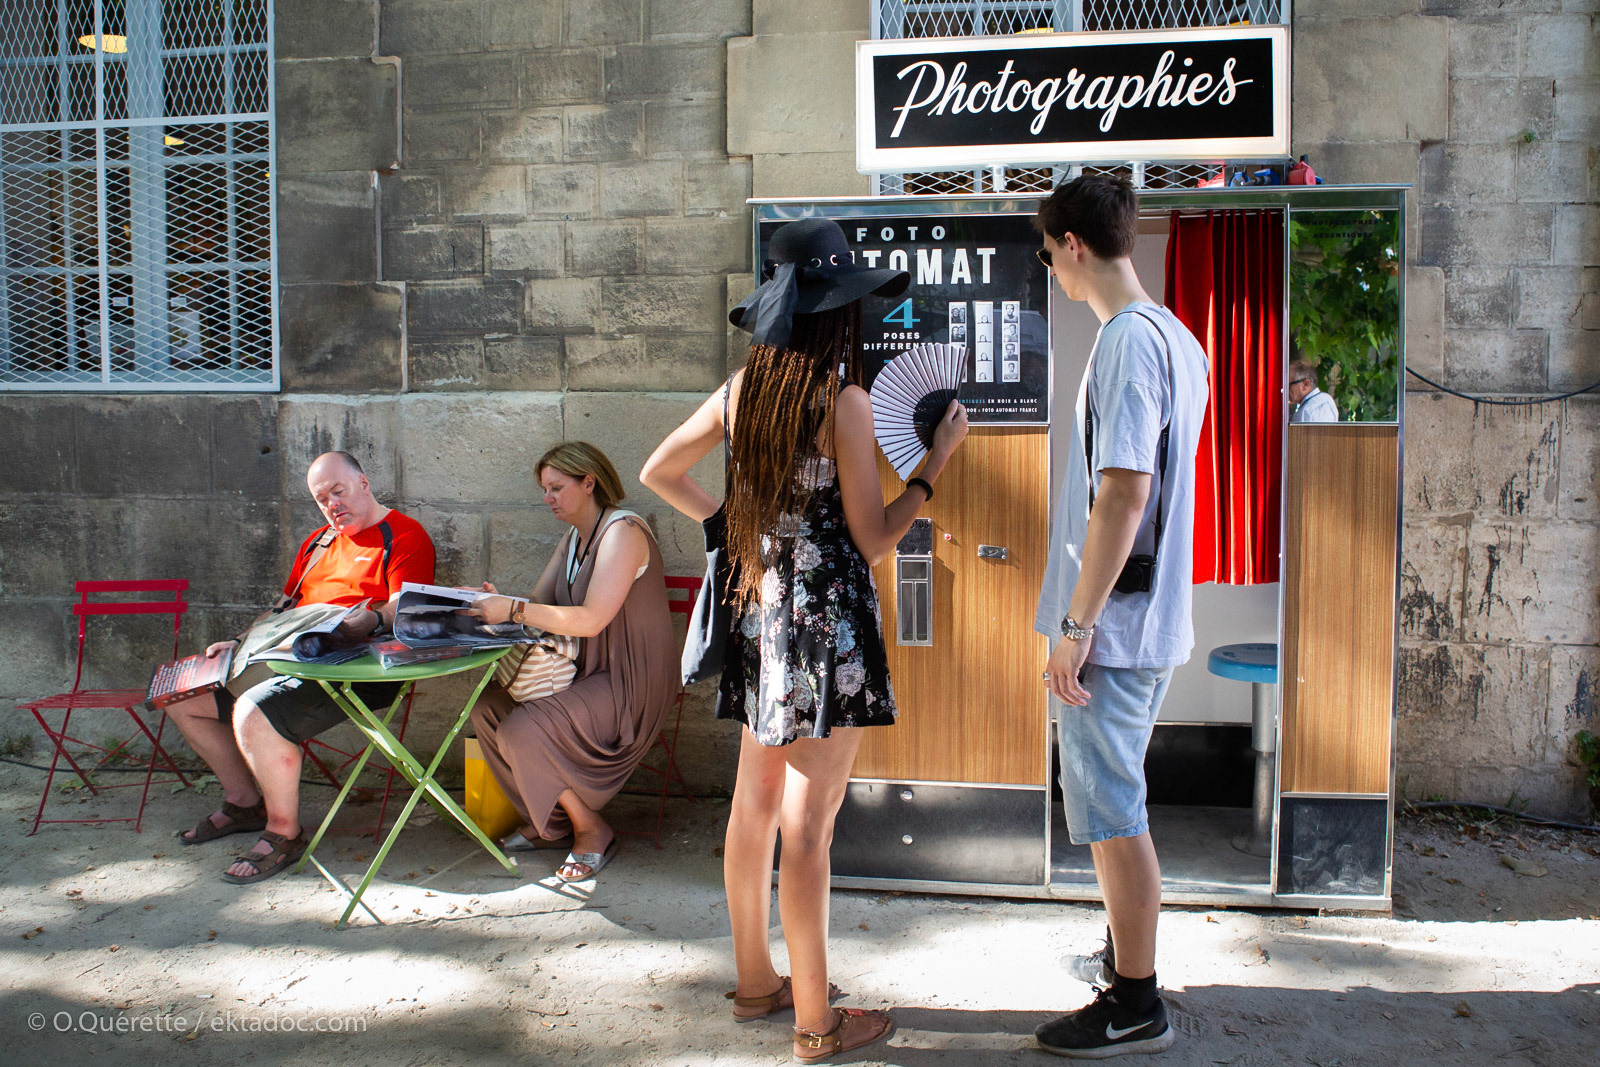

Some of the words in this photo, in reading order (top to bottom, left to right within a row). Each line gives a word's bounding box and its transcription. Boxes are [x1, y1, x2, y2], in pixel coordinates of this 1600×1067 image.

[890, 50, 1254, 138] Photographies
[856, 225, 946, 242] FOTO
[850, 247, 997, 285] TOMAT
[882, 298, 921, 329] 4
[863, 342, 941, 350] DIFFERENT
[883, 332, 920, 340] POSES
